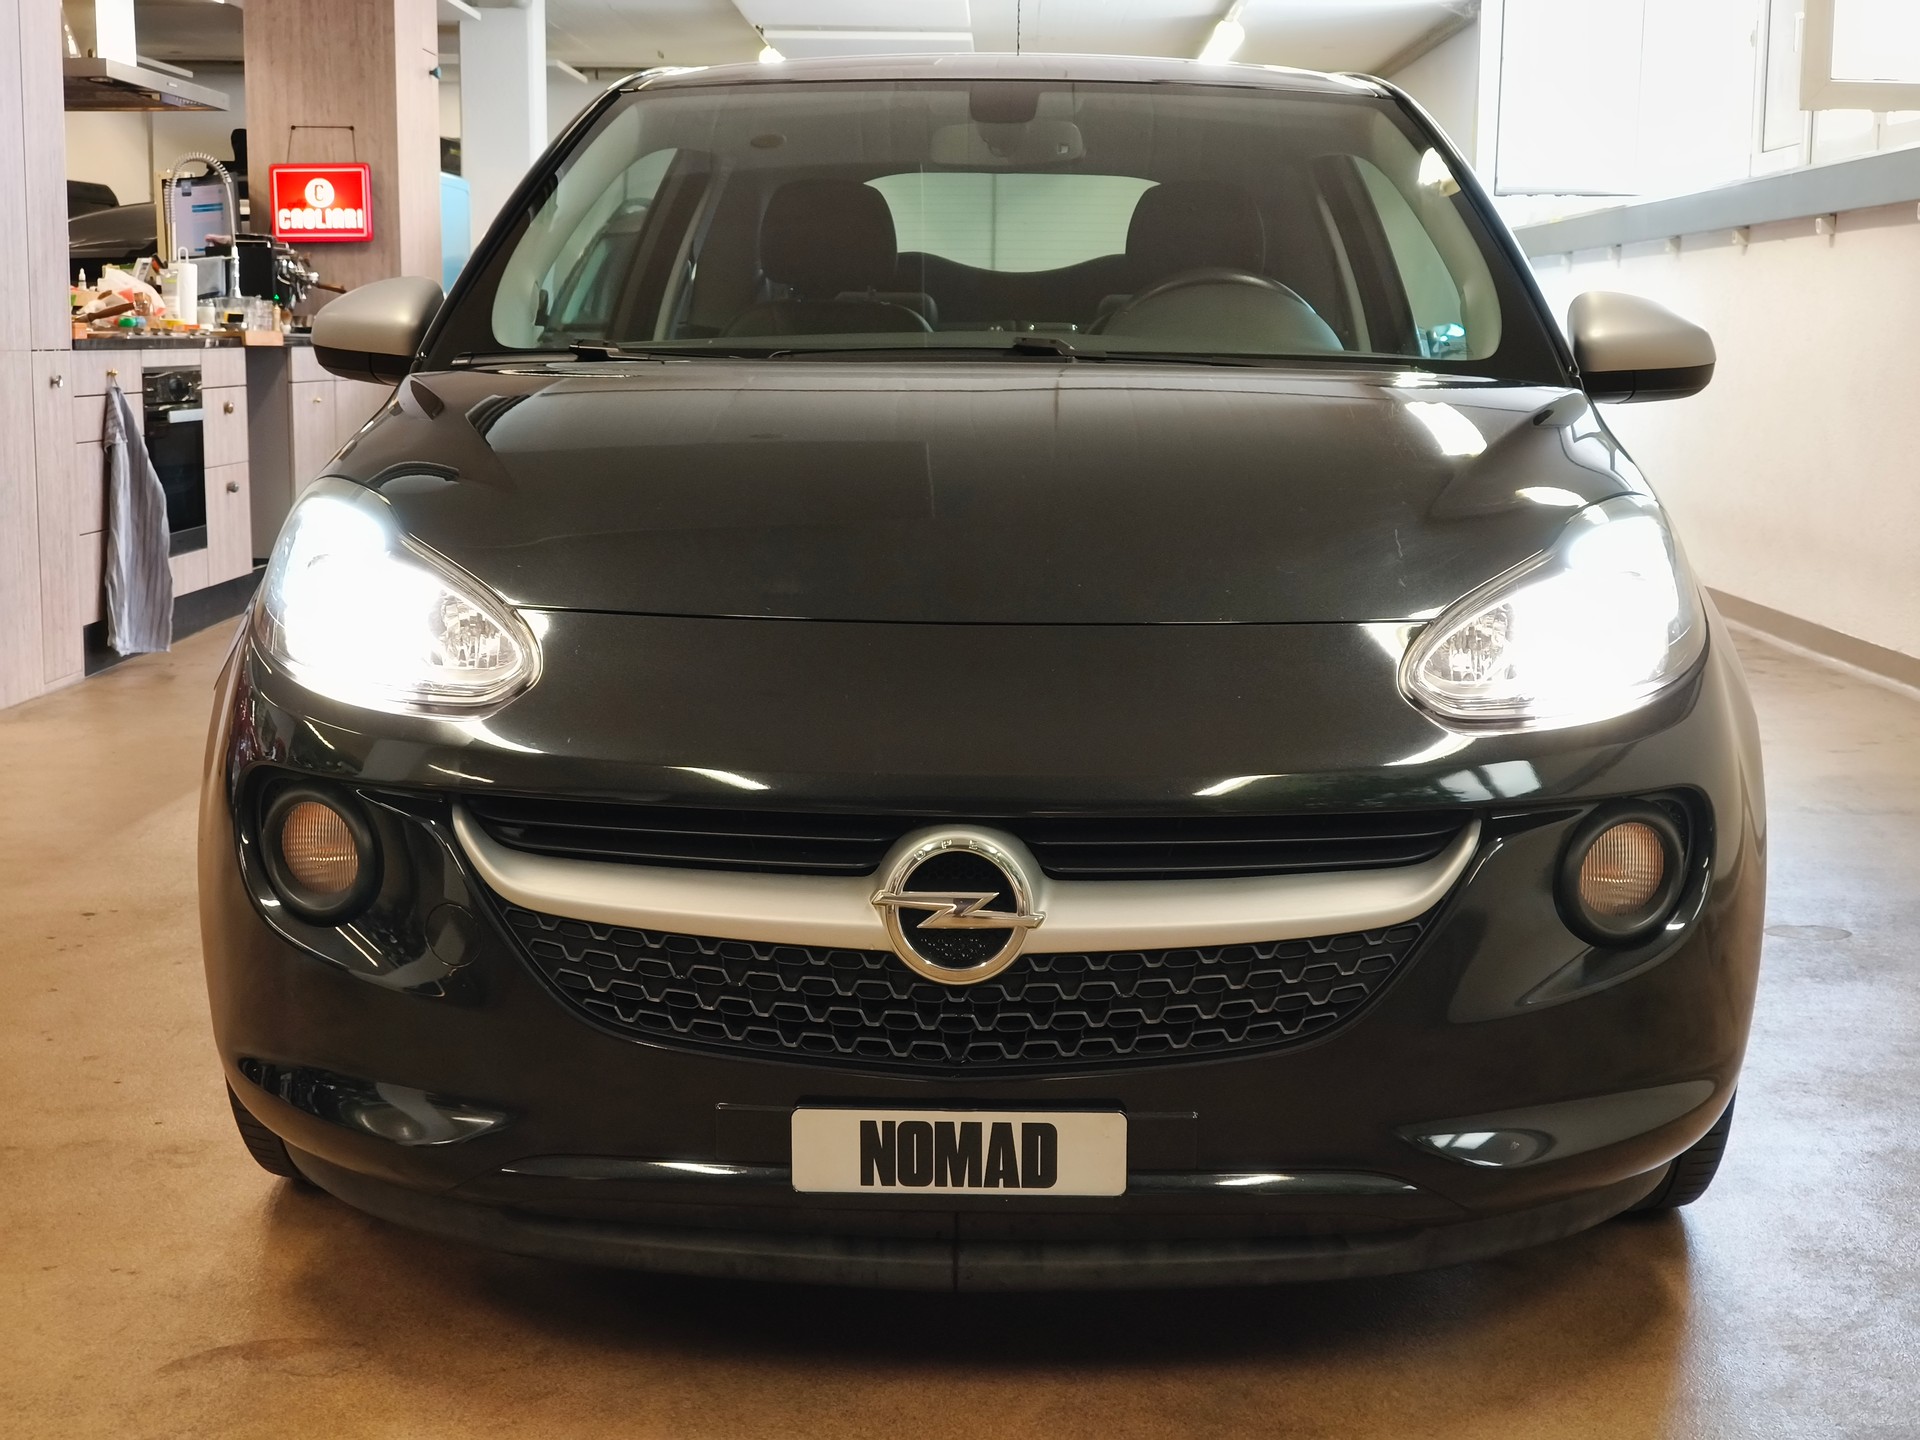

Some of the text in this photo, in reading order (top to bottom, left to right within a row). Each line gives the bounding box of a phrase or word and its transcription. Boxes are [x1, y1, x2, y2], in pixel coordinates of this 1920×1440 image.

[314, 184, 324, 202] C
[914, 839, 1002, 862] OPEL
[859, 1120, 1058, 1189] NOMAD
